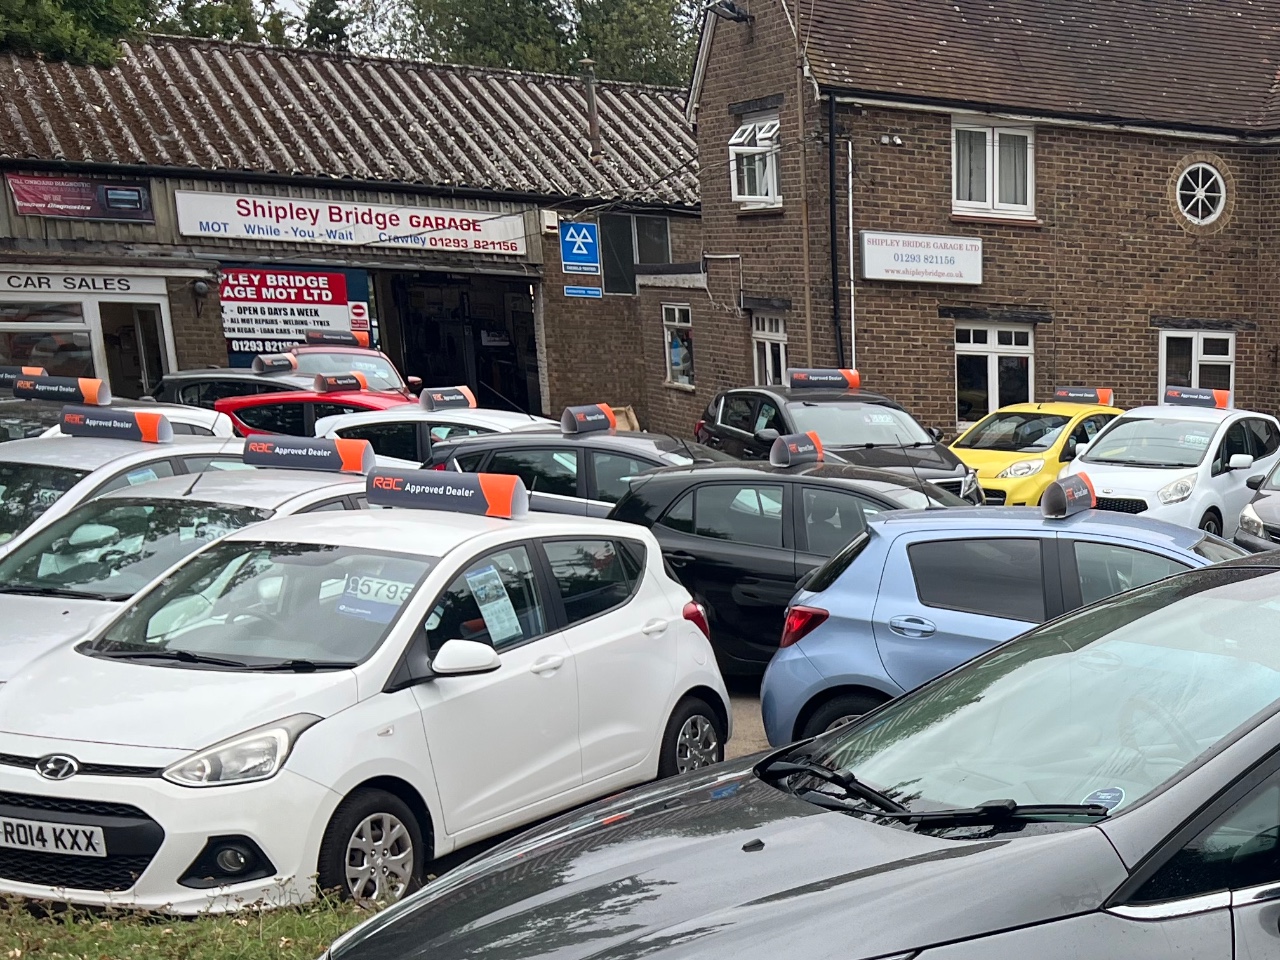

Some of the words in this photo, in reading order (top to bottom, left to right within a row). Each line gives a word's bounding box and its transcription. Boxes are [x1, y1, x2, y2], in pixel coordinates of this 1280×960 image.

[236, 198, 320, 226] Shipley
[328, 205, 401, 230] Bridge
[409, 214, 483, 232] GARAGE
[199, 220, 230, 233] MOT
[244, 223, 281, 237] While
[291, 226, 316, 239] You
[325, 228, 354, 242] Wait
[378, 232, 427, 247] Crawley
[429, 237, 469, 249] 01293
[473, 241, 519, 252] 821156
[866, 237, 901, 248] SHIPLEY
[902, 240, 932, 249] BRIDGE
[932, 241, 964, 251] GARAGE
[965, 243, 980, 252] LTD
[893, 252, 921, 263] 01293
[923, 254, 955, 265] 821156
[884, 267, 964, 279] www.shipleybridge.co.uk
[6, 275, 52, 289] CAR
[62, 276, 131, 291] SALES
[265, 274, 329, 289] BRIDGE
[261, 287, 298, 301] MOT
[302, 288, 333, 302] LTD
[236, 305, 262, 316] OPEN
[261, 306, 267, 316] 6
[267, 307, 289, 317] DAYS
[295, 308, 320, 318] WEEK
[231, 340, 264, 352] 01293
[35, 383, 59, 392] Approved
[85, 418, 112, 428] Approved
[112, 420, 133, 429] Dealer
[274, 446, 307, 456] Approved
[307, 447, 332, 457] Dealer
[404, 482, 444, 494] Approved
[445, 487, 475, 497] Dealer
[3, 821, 48, 848] RO14
[52, 826, 98, 853] KXX
